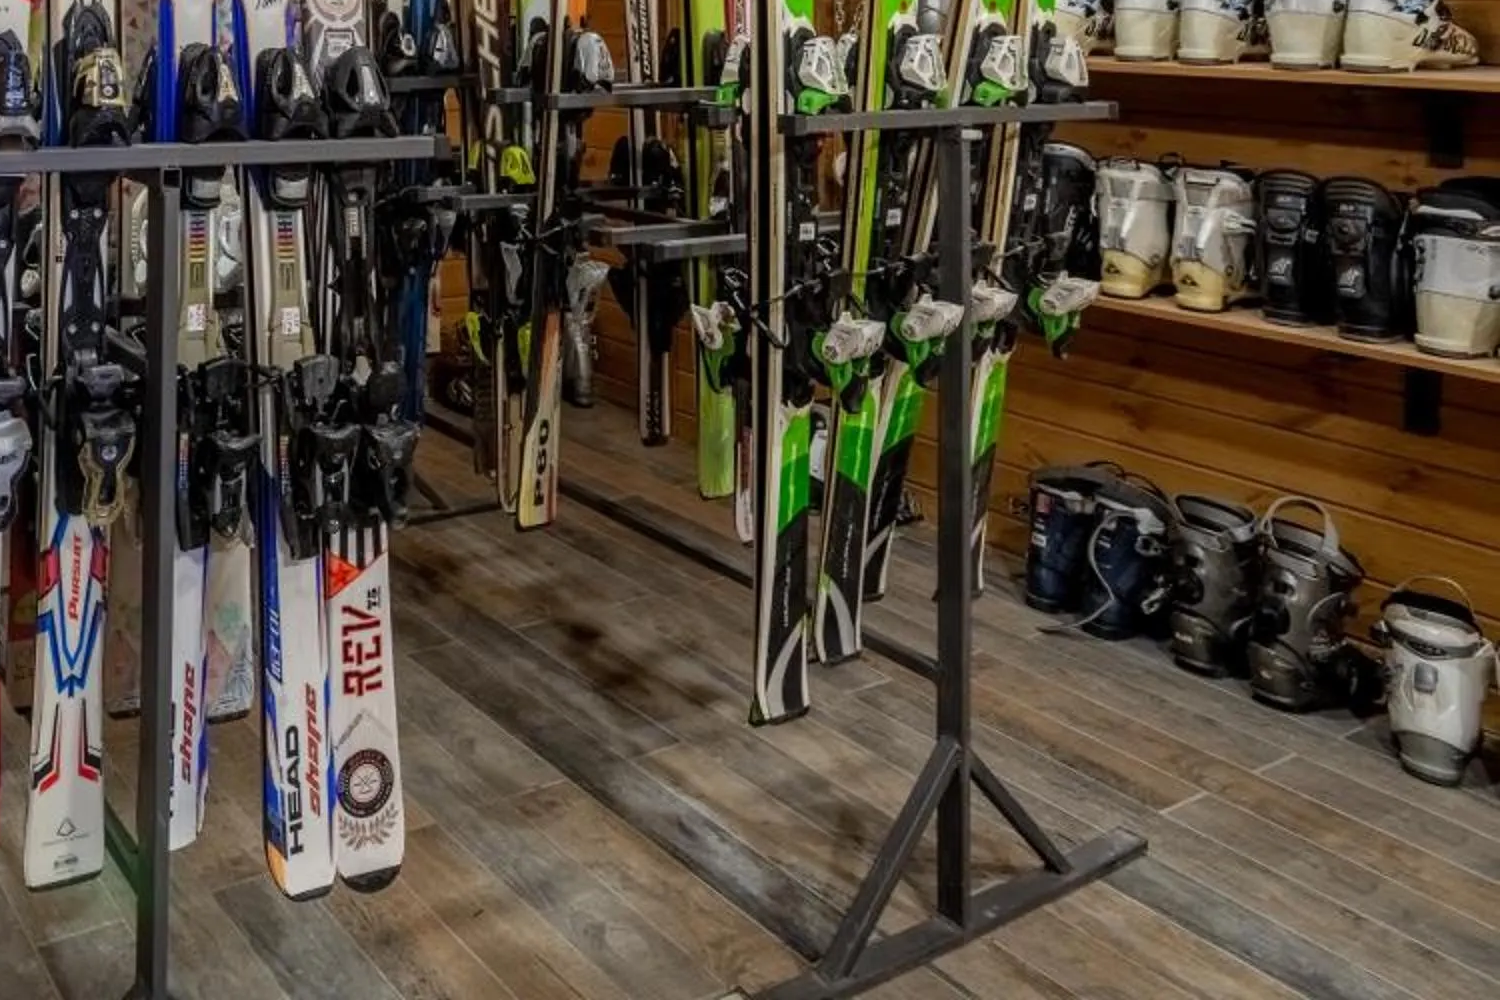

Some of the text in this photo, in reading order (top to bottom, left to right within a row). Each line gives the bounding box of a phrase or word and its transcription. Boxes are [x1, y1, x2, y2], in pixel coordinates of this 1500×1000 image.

[534, 418, 549, 506] P60
[68, 534, 82, 622] PURSUIT
[342, 605, 382, 697] REV
[286, 724, 303, 856] HEAD
